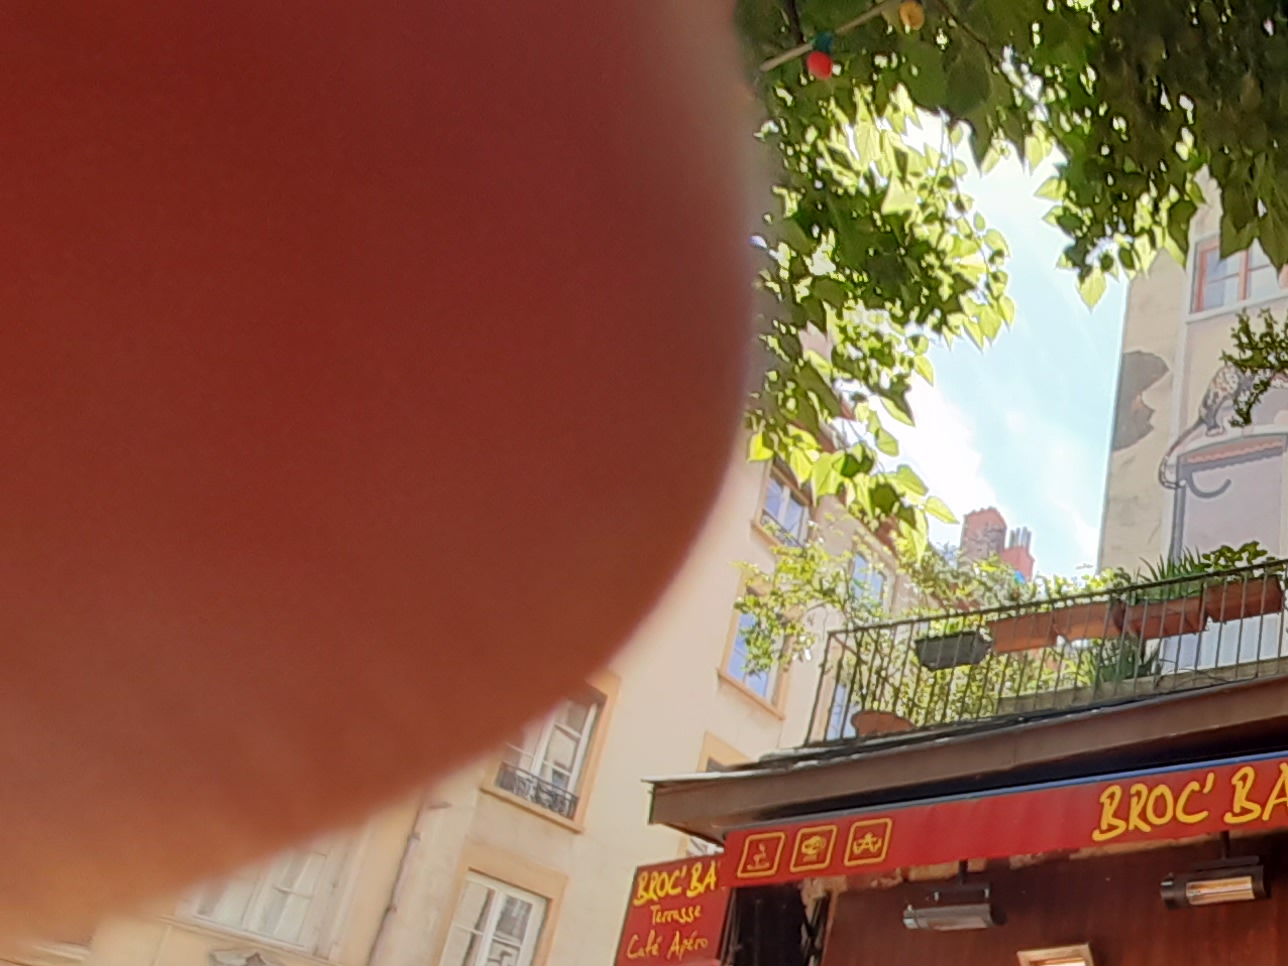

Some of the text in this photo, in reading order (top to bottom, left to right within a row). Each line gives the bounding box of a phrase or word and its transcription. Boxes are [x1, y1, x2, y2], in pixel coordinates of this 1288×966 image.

[1092, 772, 1215, 841] BROC'
[633, 860, 720, 906] BROC' BA
[650, 904, 701, 925] Terrasse
[627, 929, 708, 960] Café Apéro
